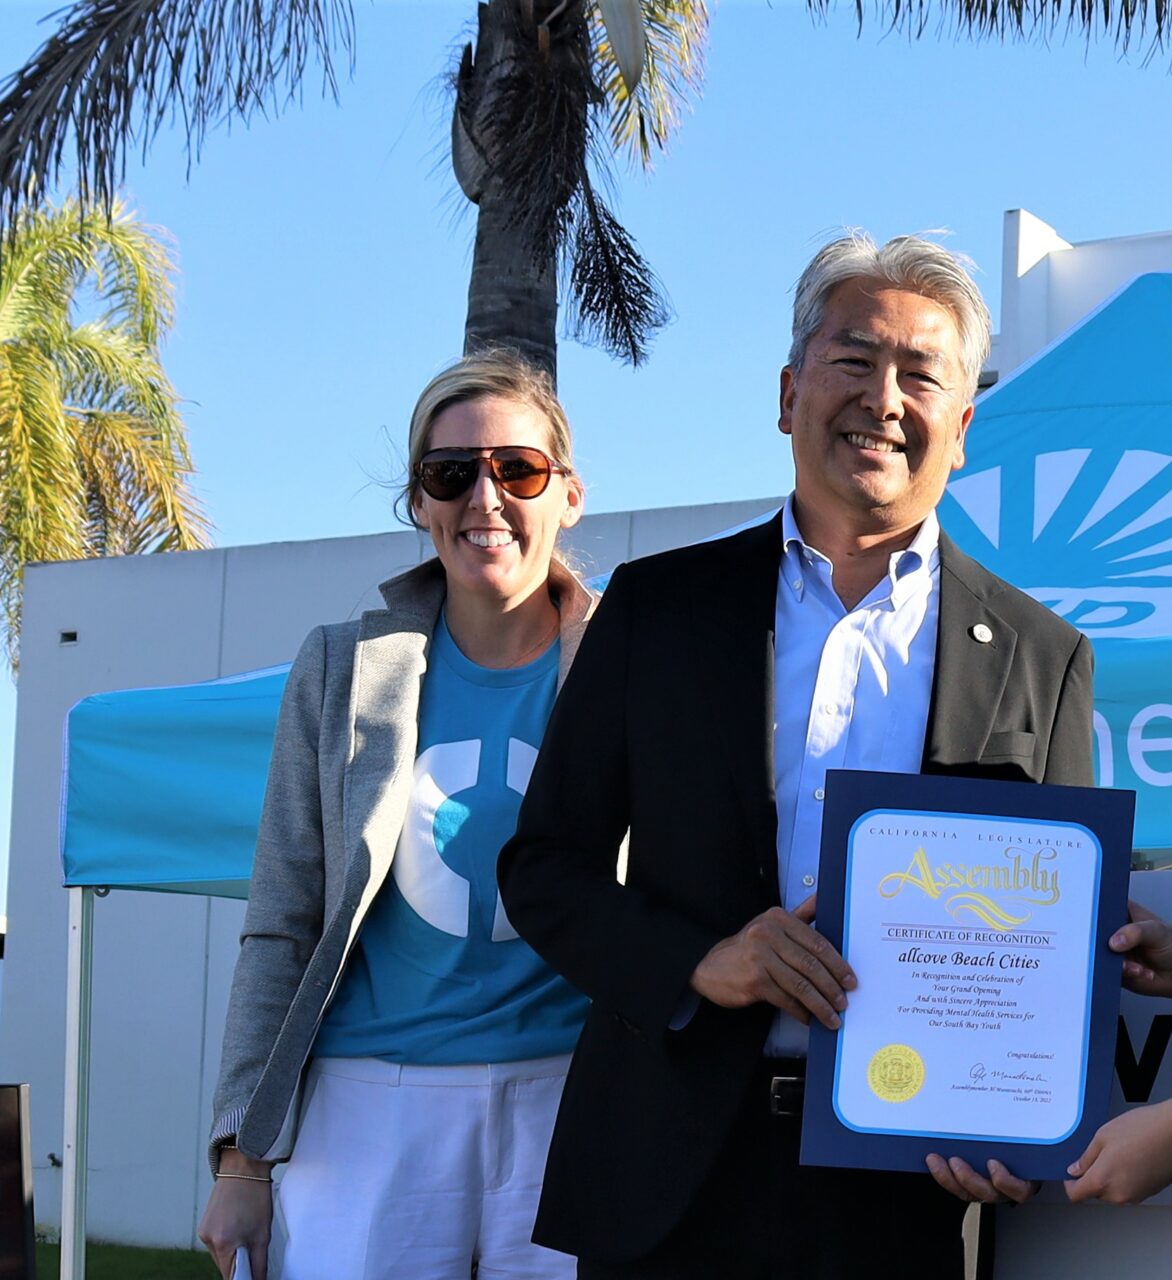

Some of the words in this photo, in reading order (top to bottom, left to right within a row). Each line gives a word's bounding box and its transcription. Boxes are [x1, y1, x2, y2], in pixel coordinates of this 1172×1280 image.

[869, 827, 957, 840] CALIFORNIA
[978, 833, 1083, 849] LEGISLATURE
[878, 845, 1061, 906] Assembly
[887, 927, 955, 941] CERTIFICATE
[957, 931, 972, 941] OF
[974, 932, 1050, 945] RECOGNITION
[898, 947, 947, 964] allcove
[951, 951, 995, 967] Beach
[999, 954, 1040, 970] Cities
[911, 971, 920, 979] In
[921, 971, 961, 982] Recognition
[962, 973, 975, 981] and
[976, 974, 1015, 984] Celebration
[1016, 975, 1025, 986] of
[932, 984, 949, 992] Your
[950, 984, 972, 993] Grand
[973, 986, 1001, 997] Opening
[915, 995, 930, 1003] And
[931, 995, 948, 1004] with
[949, 997, 972, 1005] Sincere
[974, 998, 1017, 1008] Appreciation
[897, 1005, 910, 1014] For
[911, 1006, 944, 1017] Providing
[945, 1008, 970, 1016] Mental
[970, 1009, 995, 1018] Health
[996, 1011, 1023, 1020] Services
[1023, 1012, 1035, 1021] for
[928, 1019, 943, 1028] Our
[943, 1020, 964, 1029] South
[965, 1021, 979, 1031] Bay
[980, 1022, 1001, 1030] Youth
